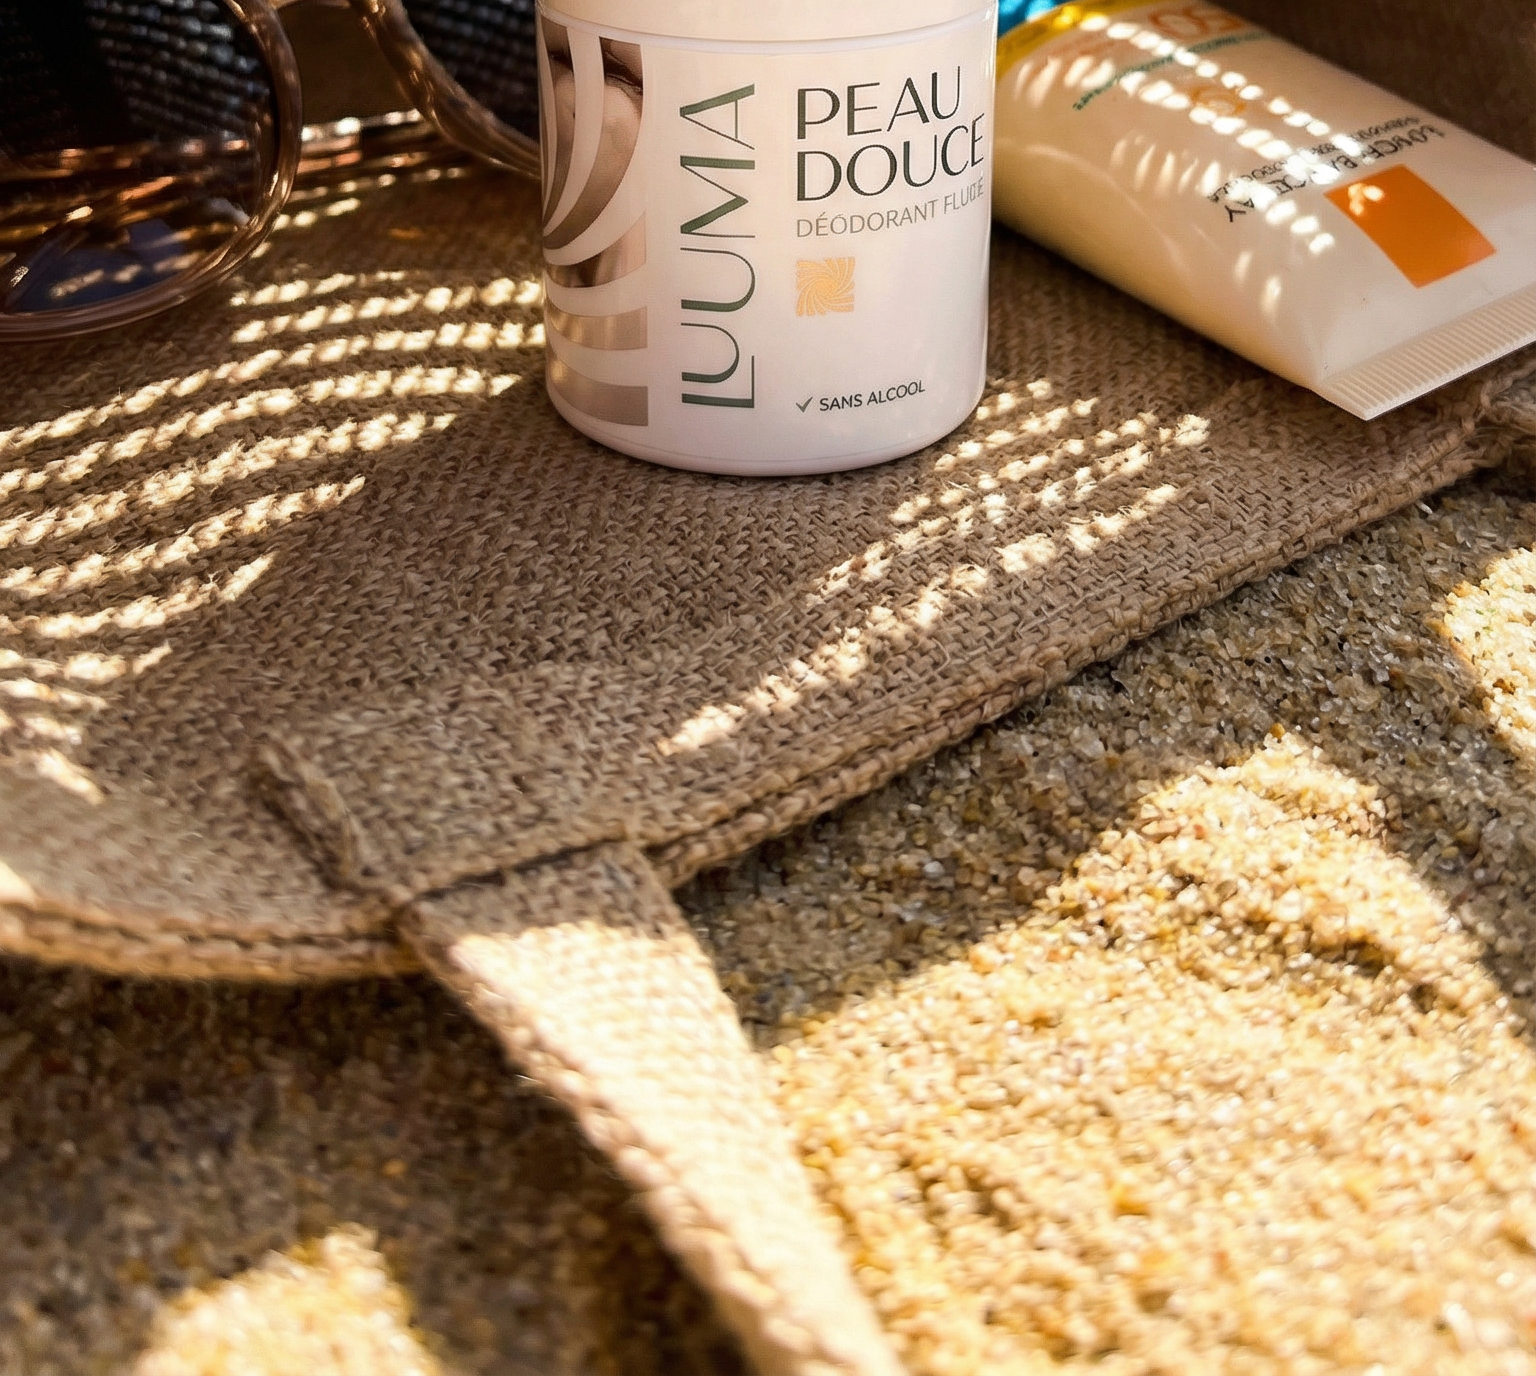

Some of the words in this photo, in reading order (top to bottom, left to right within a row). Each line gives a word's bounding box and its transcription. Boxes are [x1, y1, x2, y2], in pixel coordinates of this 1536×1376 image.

[797, 66, 960, 139] PEAU
[797, 113, 985, 201] DOUCE
[680, 83, 755, 409] LUUMA
[819, 393, 863, 412] SANS
[866, 380, 926, 406] ALCOOL
